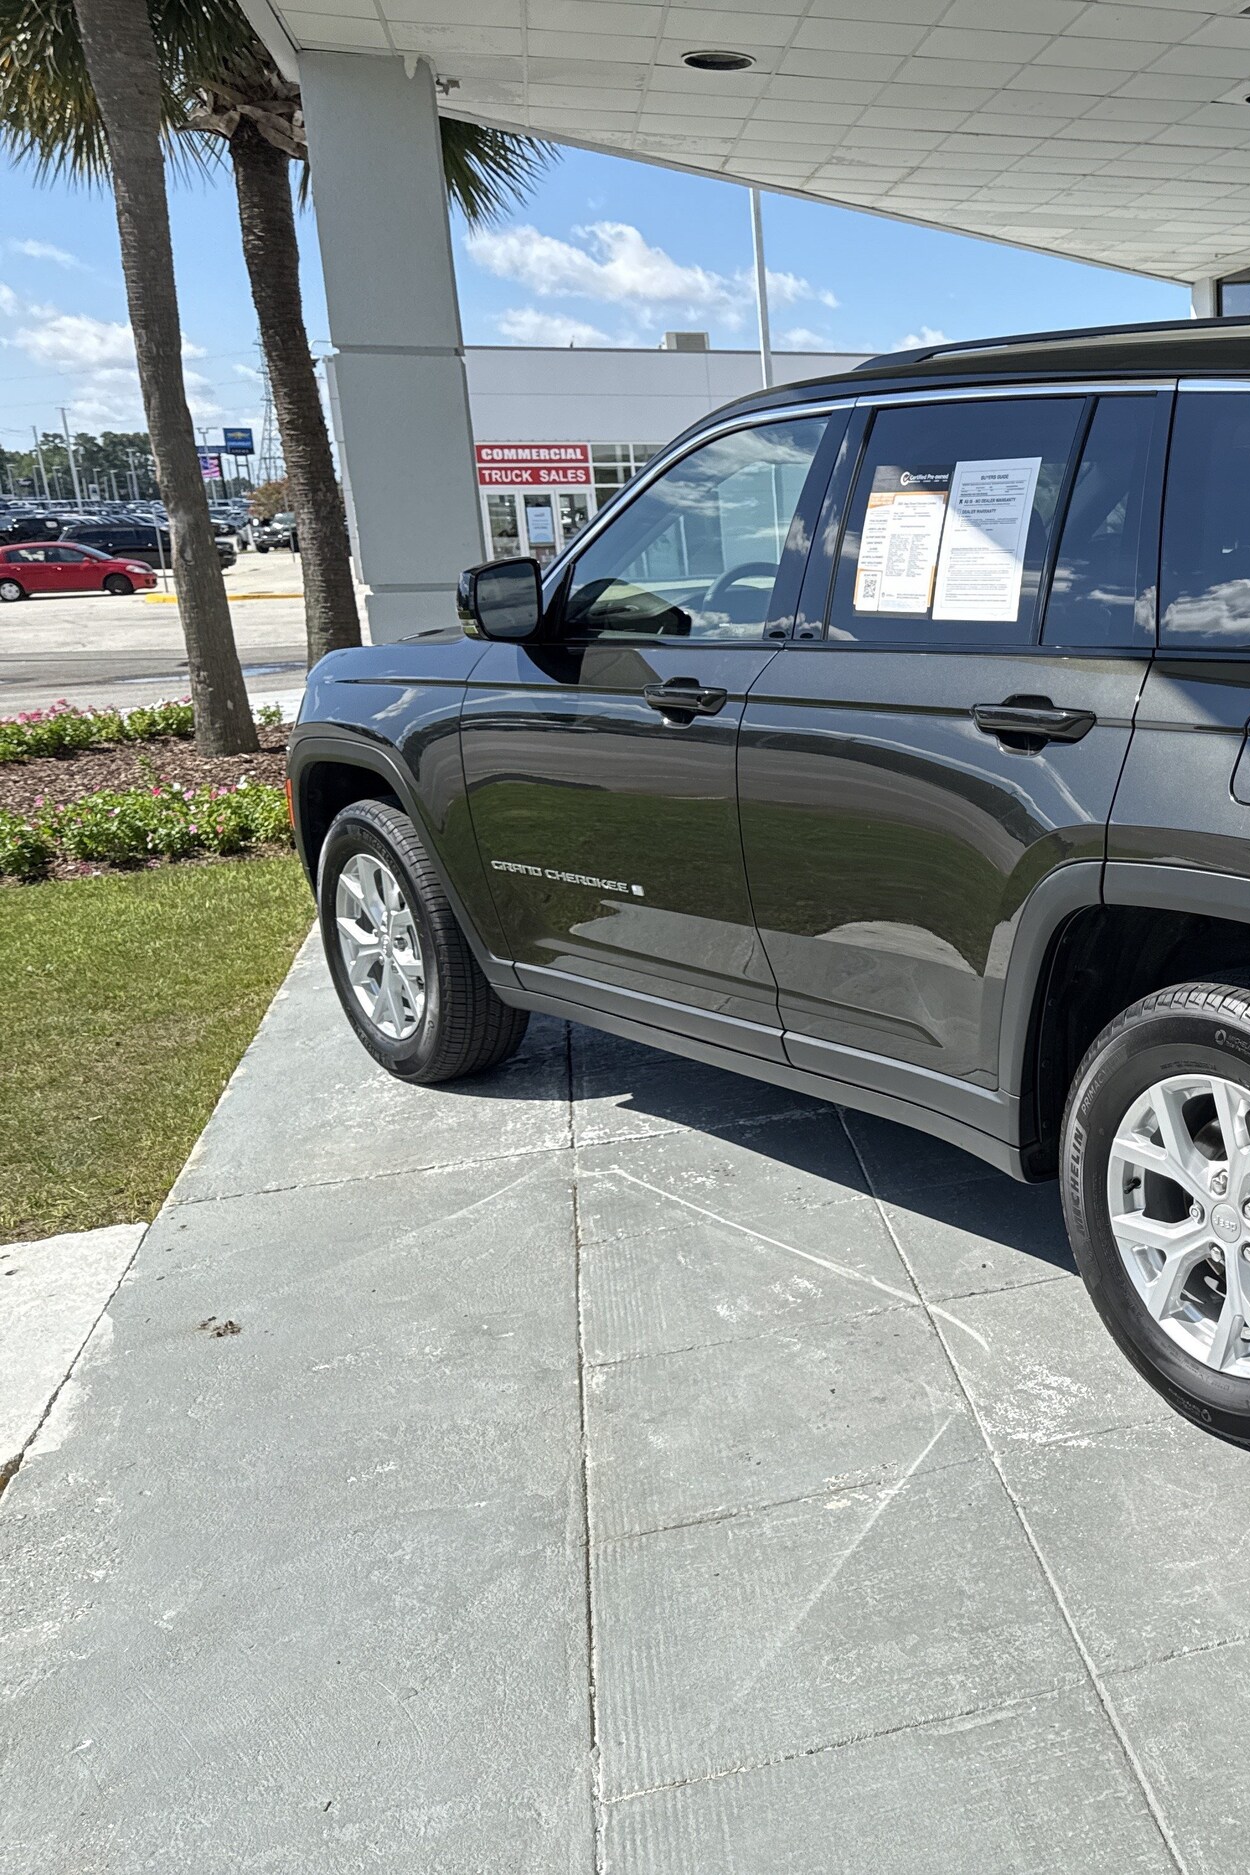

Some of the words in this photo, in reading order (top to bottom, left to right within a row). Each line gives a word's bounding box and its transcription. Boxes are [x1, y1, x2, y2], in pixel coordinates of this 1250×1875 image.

[480, 448, 585, 461] COMMERCIAL
[482, 470, 533, 483] TRUCK
[539, 470, 588, 482] SALES
[490, 860, 543, 877] GRAND
[544, 868, 630, 893] CHEROKEE
[1070, 1126, 1086, 1237] MICHELIN
[1213, 1214, 1238, 1233] Jeep
